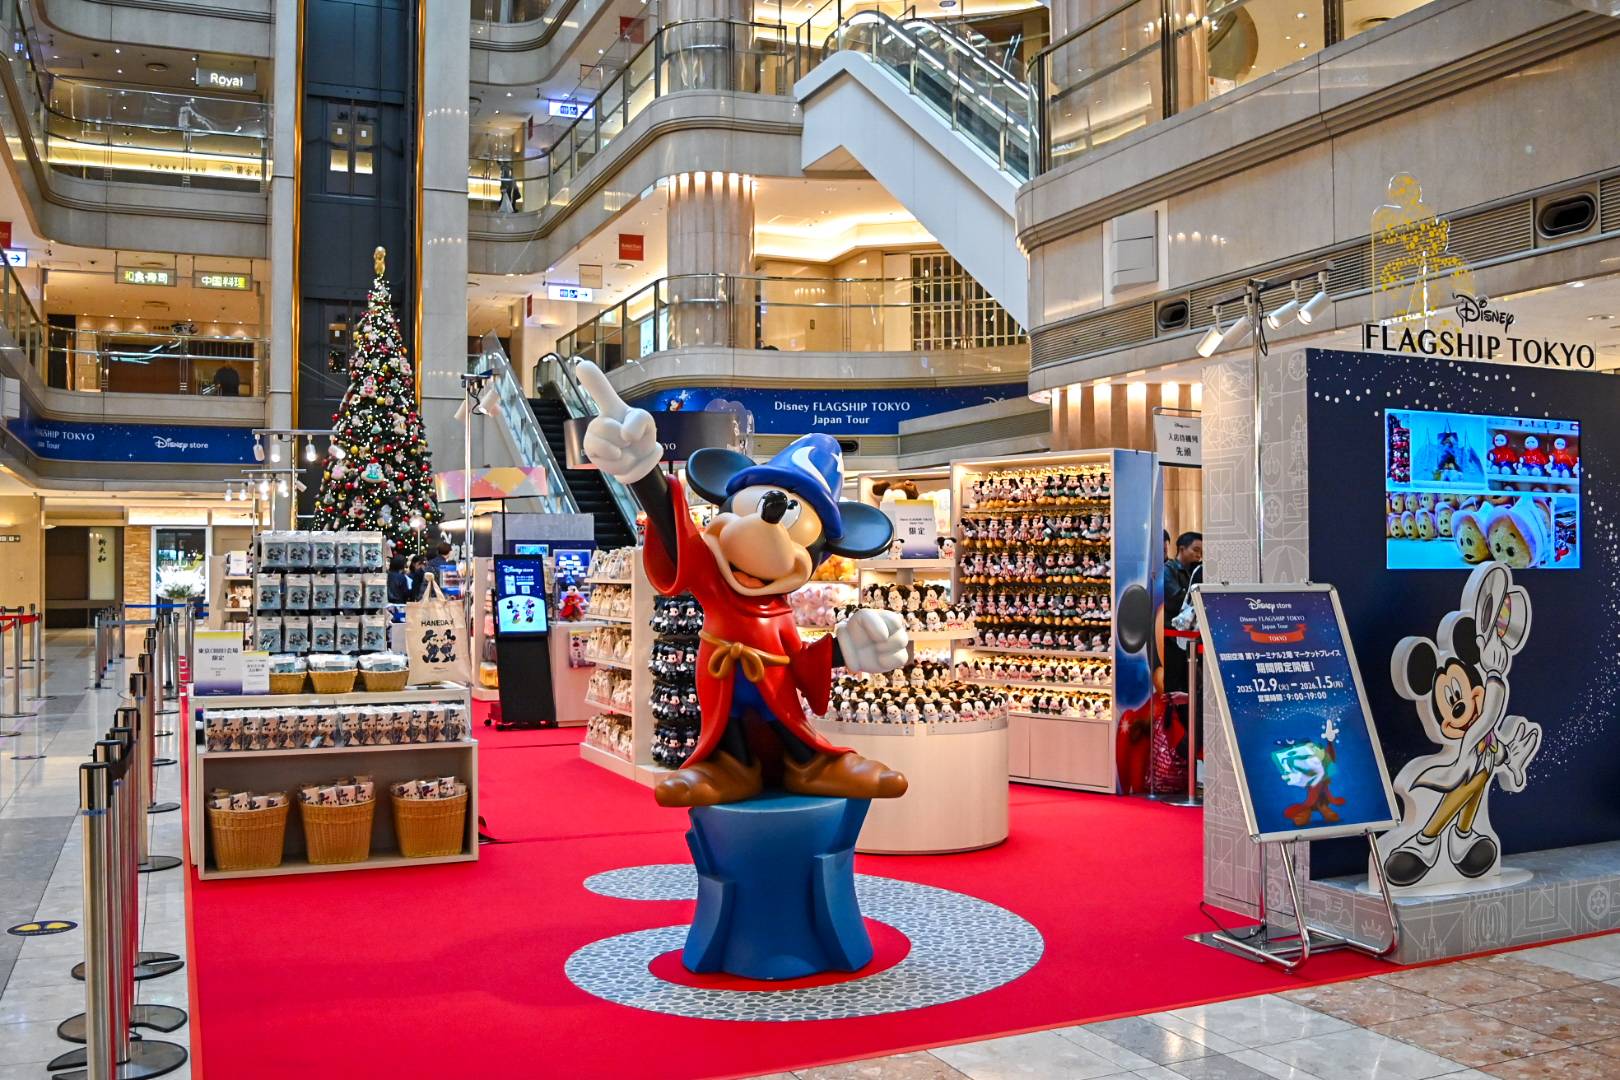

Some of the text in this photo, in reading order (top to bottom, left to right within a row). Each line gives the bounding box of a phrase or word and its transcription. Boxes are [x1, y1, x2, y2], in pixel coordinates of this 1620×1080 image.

[210, 72, 244, 87] Royal
[201, 275, 246, 288] 中国料理
[1452, 291, 1515, 333] Disney
[1365, 323, 1596, 369] FLAGSHIP TOKYO
[774, 401, 911, 413] Disney FLAGSHIP TOKYO
[812, 414, 870, 426] Japan Tour
[62, 431, 95, 441] TOKYO
[1168, 432, 1199, 443] 入店待機列
[153, 435, 188, 452] Disney
[1175, 446, 1192, 457] 先頭
[1245, 597, 1276, 613] Disney
[420, 619, 449, 627] HANEDA
[1261, 623, 1276, 631] Japan
[1293, 649, 1341, 658] マーケットプレイス
